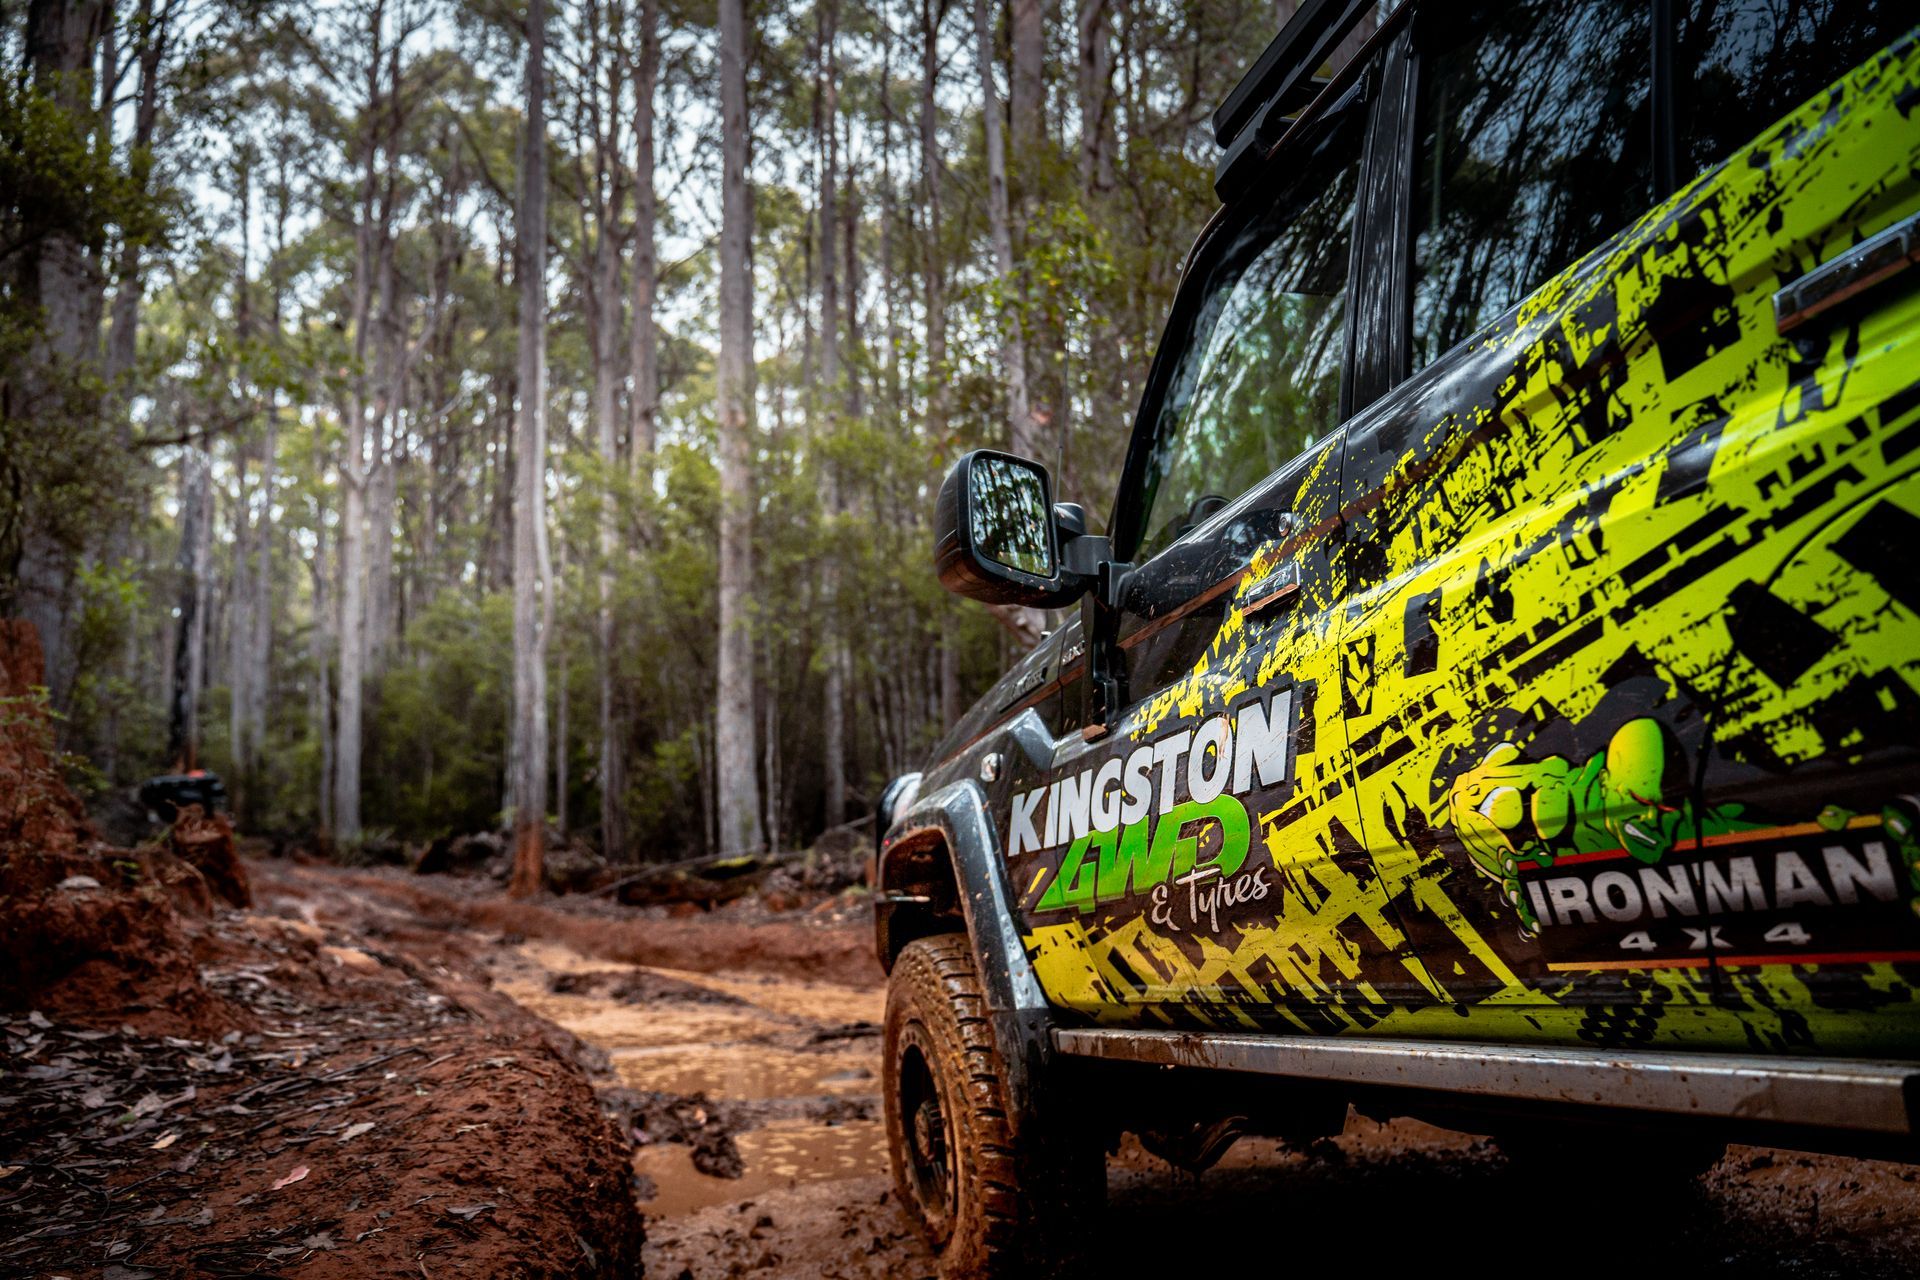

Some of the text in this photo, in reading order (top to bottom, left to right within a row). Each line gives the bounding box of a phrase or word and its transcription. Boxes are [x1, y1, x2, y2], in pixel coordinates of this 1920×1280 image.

[1007, 689, 1292, 857] KINGSTON
[1034, 794, 1250, 913] 4WD
[1176, 867, 1271, 932] Tyres
[1526, 842, 1899, 926] IRONMAN
